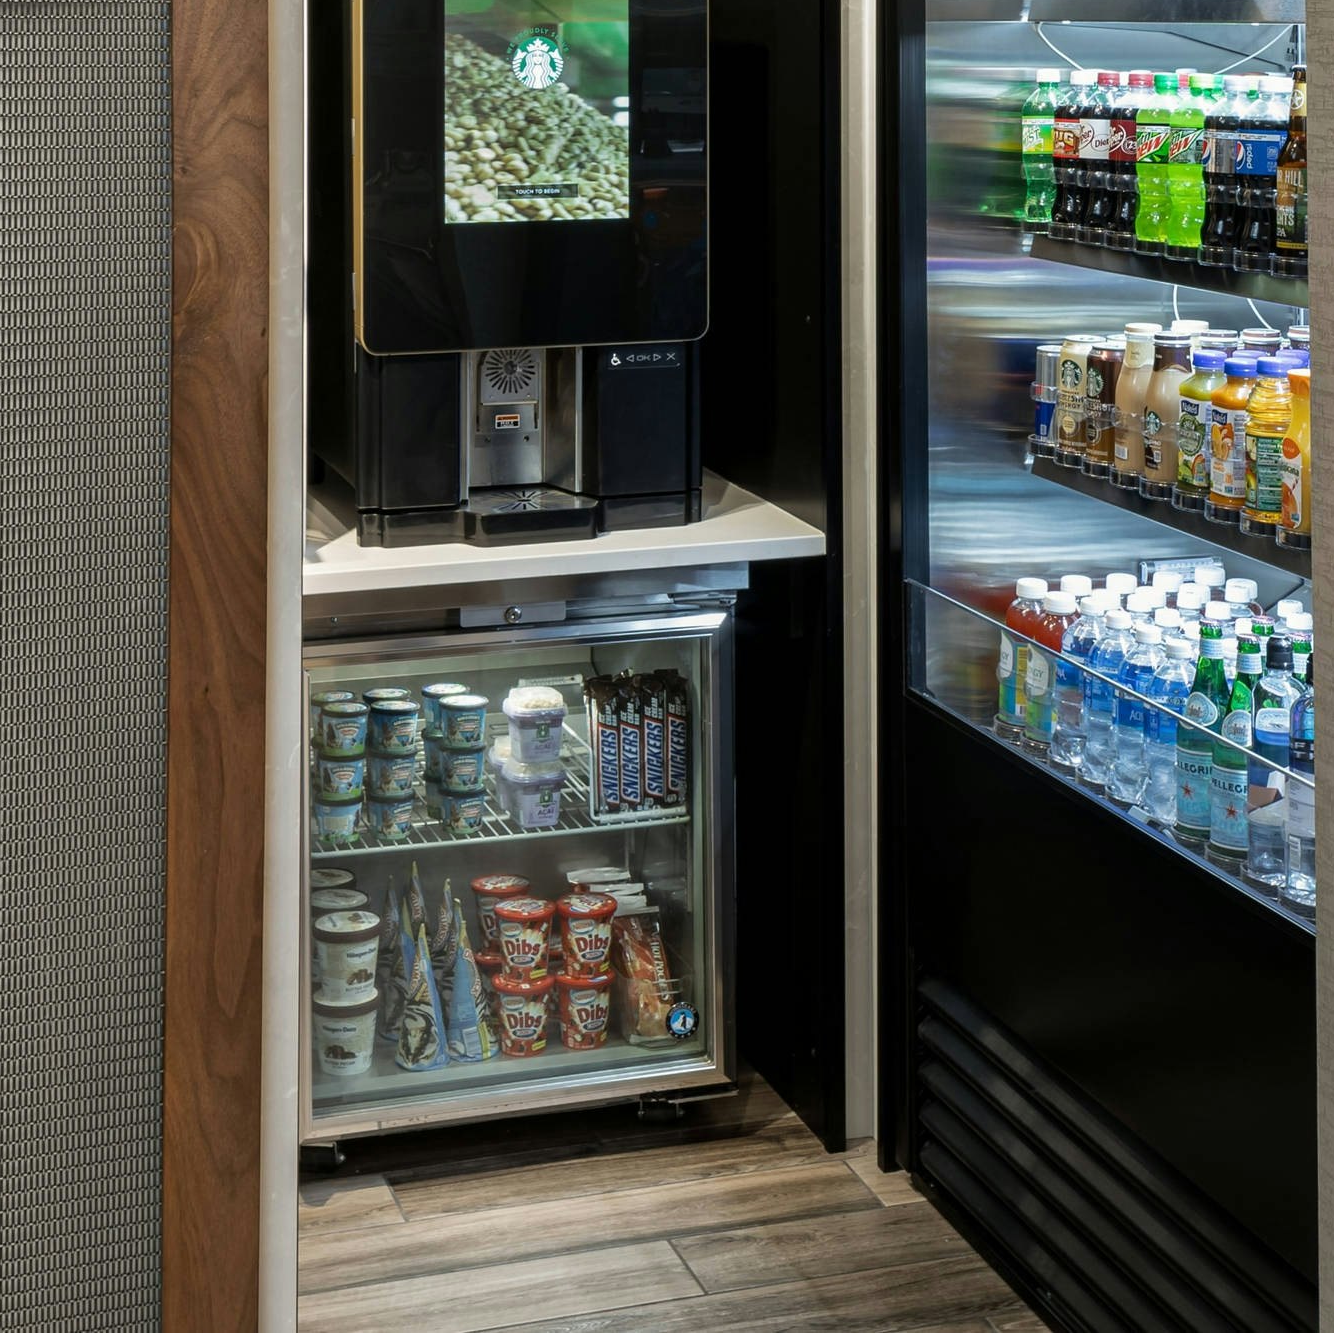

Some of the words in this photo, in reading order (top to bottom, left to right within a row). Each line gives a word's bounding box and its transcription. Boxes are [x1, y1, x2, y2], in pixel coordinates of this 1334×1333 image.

[1054, 130, 1074, 145] UG
[1285, 170, 1303, 187] HILL
[622, 726, 639, 800] SNICKERS
[646, 721, 663, 795] SNICKERS
[670, 720, 686, 788] SNICKERS
[601, 729, 619, 802] SNICKERS
[504, 938, 541, 957] Dibs
[575, 934, 610, 952] Dibs
[507, 1011, 542, 1029] Dibs
